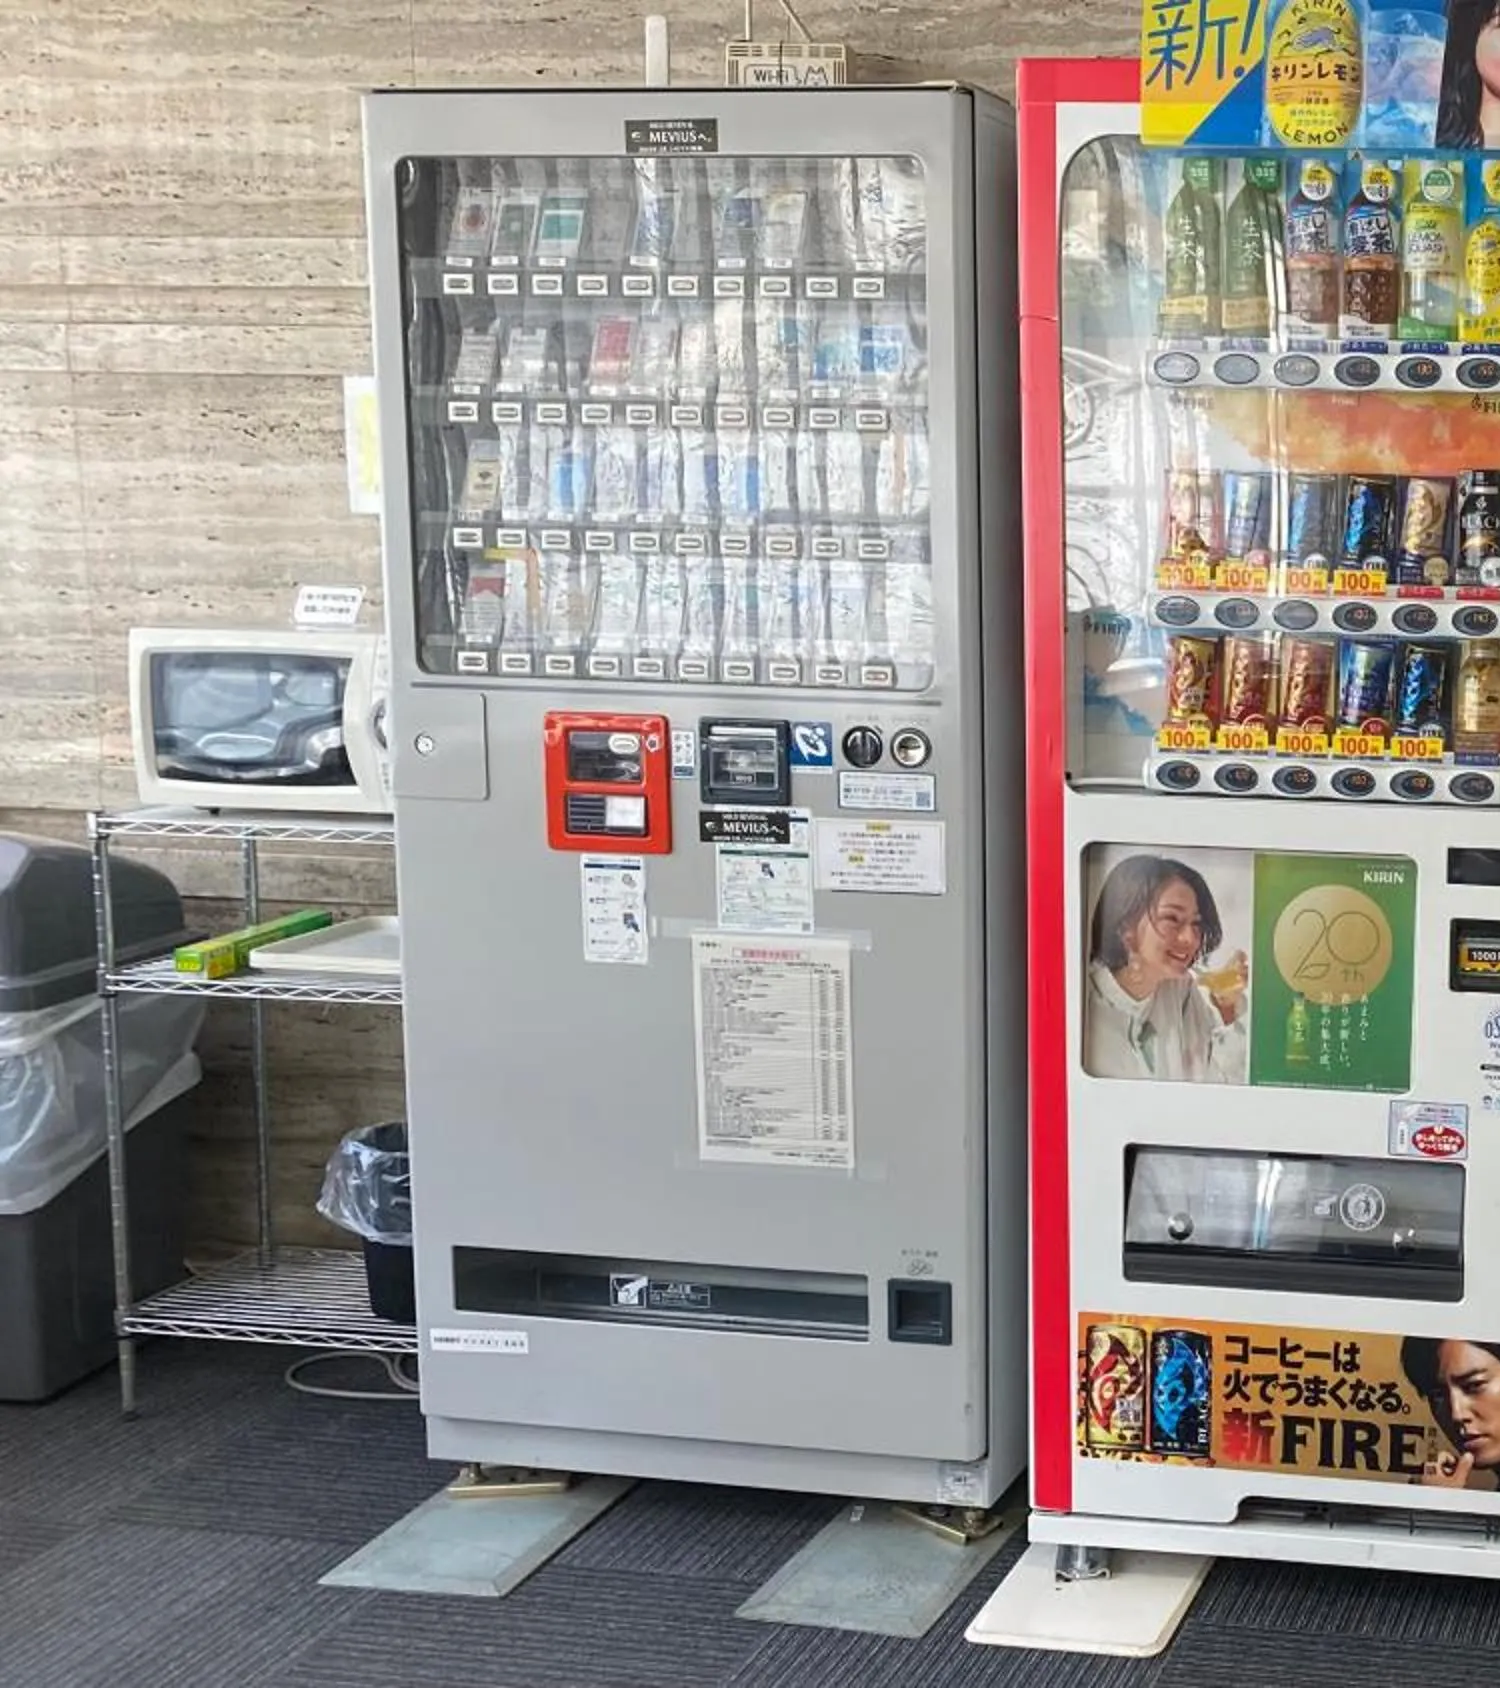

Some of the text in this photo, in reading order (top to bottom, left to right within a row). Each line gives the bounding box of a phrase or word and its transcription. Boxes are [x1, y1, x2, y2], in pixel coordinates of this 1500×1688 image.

[1271, 62, 1360, 82] キリンレモン
[1283, 122, 1349, 145] LEMON
[1363, 870, 1405, 884] KIRIN
[1293, 908, 1380, 979] 20
[1224, 1335, 1361, 1373] コーヒーは
[1223, 1368, 1411, 1415] 火でうまくなる。
